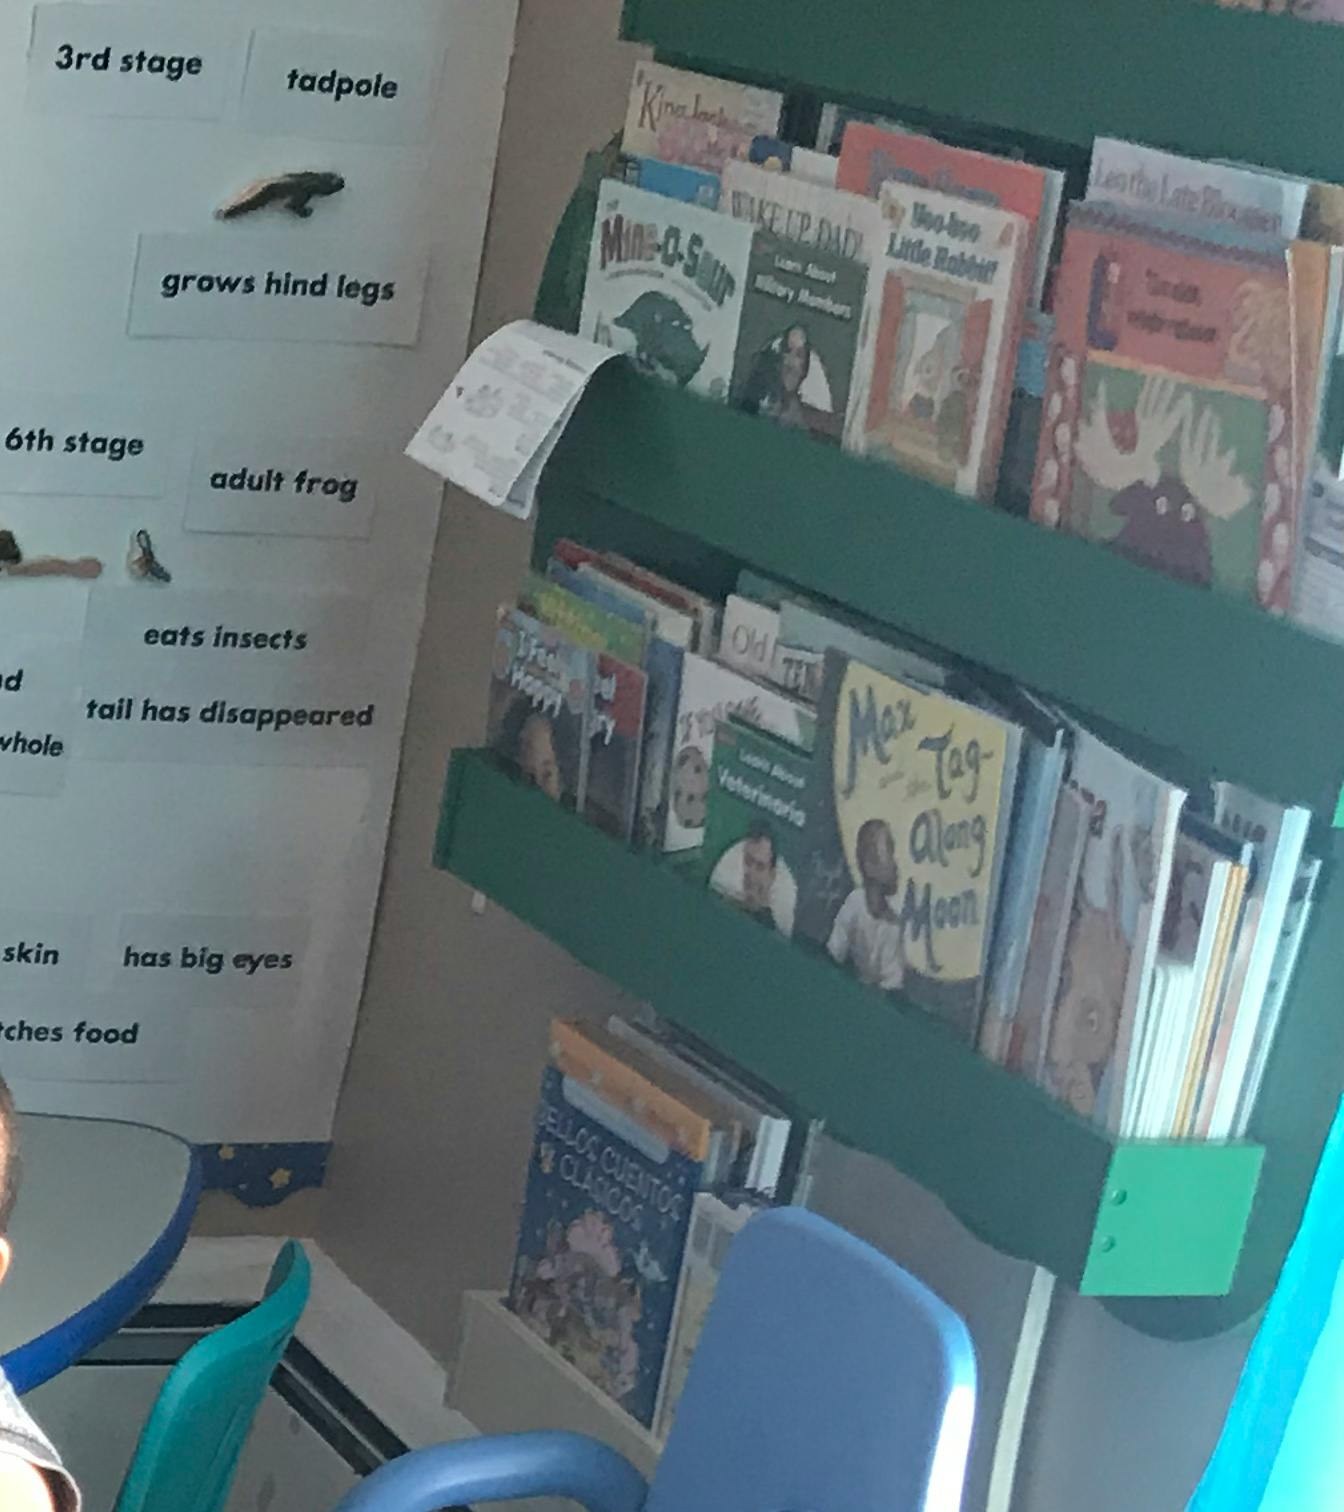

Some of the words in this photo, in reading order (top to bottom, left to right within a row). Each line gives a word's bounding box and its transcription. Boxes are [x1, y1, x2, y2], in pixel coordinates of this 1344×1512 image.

[55, 44, 112, 71] 3rd
[119, 50, 203, 82] stage
[287, 68, 398, 102] tadpole
[161, 274, 256, 298] grows
[264, 271, 329, 297] hind
[336, 274, 395, 307] legs
[5, 426, 54, 452] 6th
[63, 432, 144, 462] stage
[210, 467, 285, 492] adult
[293, 469, 359, 503] frog
[143, 626, 205, 648] eats
[212, 625, 308, 651] insects
[732, 623, 771, 661] Old
[86, 697, 133, 721] tail
[141, 697, 191, 723] has
[199, 700, 375, 732] disappeared
[840, 684, 917, 800] Max
[916, 723, 995, 804] Tag-
[909, 808, 987, 878] Along
[899, 876, 980, 973] Moon
[2, 941, 60, 966] skin
[123, 945, 172, 968] has
[180, 946, 225, 975] big
[232, 953, 293, 976] eyes
[73, 1020, 140, 1044] food
